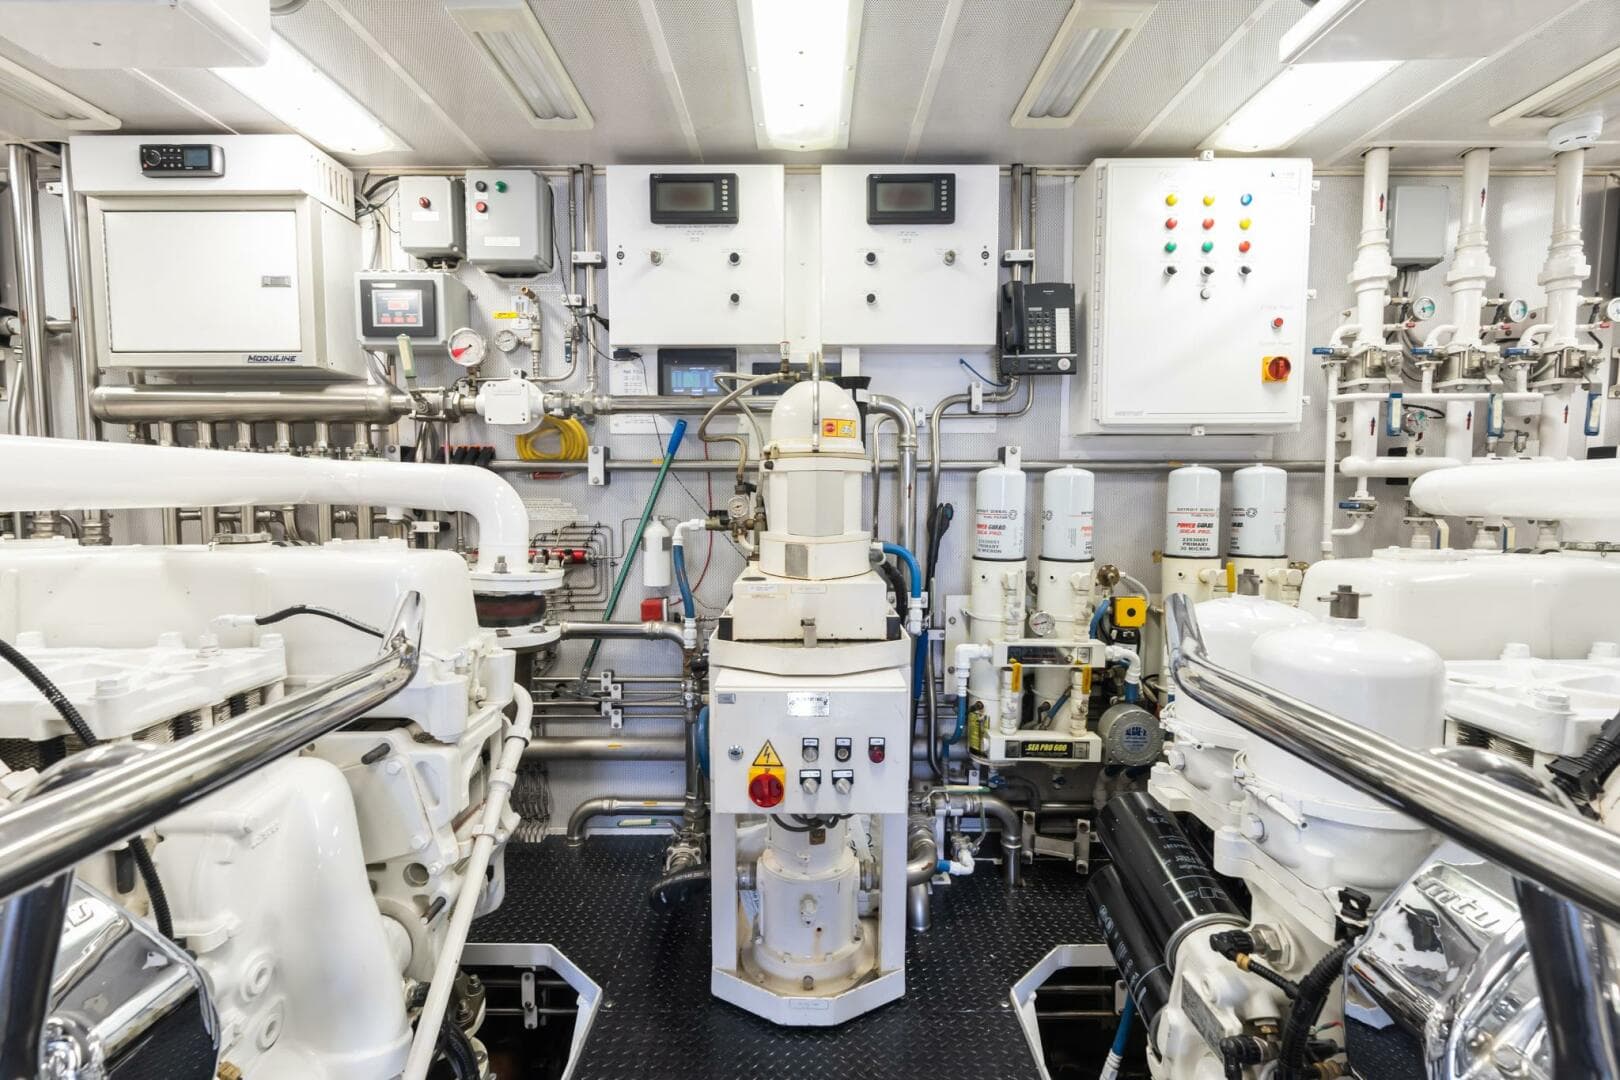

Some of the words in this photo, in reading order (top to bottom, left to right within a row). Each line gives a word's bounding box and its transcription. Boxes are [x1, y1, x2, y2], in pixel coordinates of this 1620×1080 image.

[1026, 744, 1040, 752] SEA
[1040, 744, 1053, 752] PRO
[1054, 744, 1067, 752] 600
[1415, 876, 1501, 930] mtu
